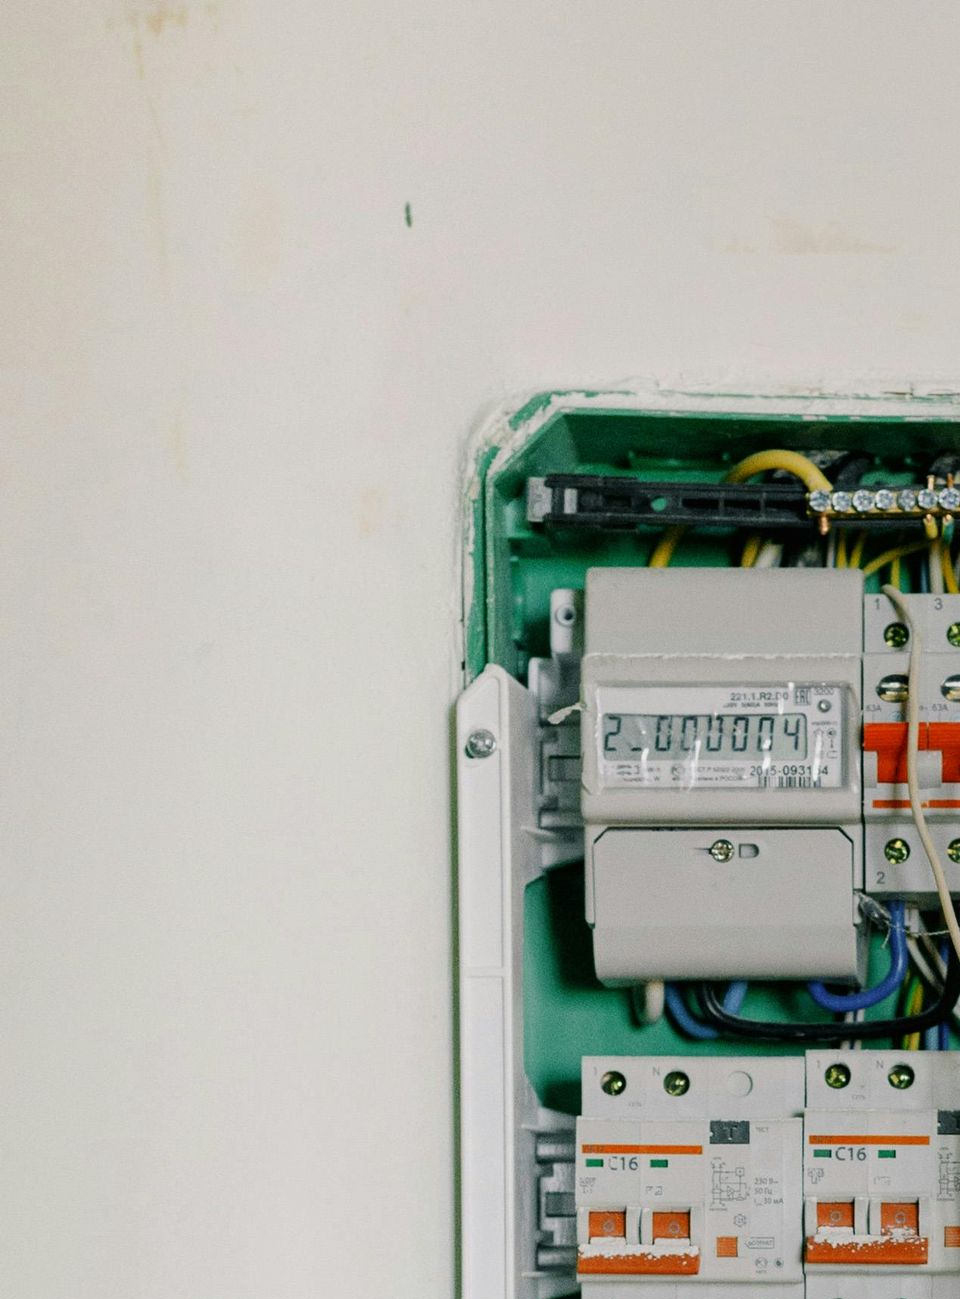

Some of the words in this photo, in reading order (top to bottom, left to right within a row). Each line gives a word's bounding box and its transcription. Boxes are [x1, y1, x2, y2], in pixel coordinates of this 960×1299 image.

[875, 598, 880, 610] 1
[934, 597, 943, 611] 3
[876, 871, 885, 884] 2
[652, 1066, 660, 1076] N
[876, 1060, 884, 1069] N
[835, 1147, 867, 1161] C16
[608, 1156, 638, 1171] C16
